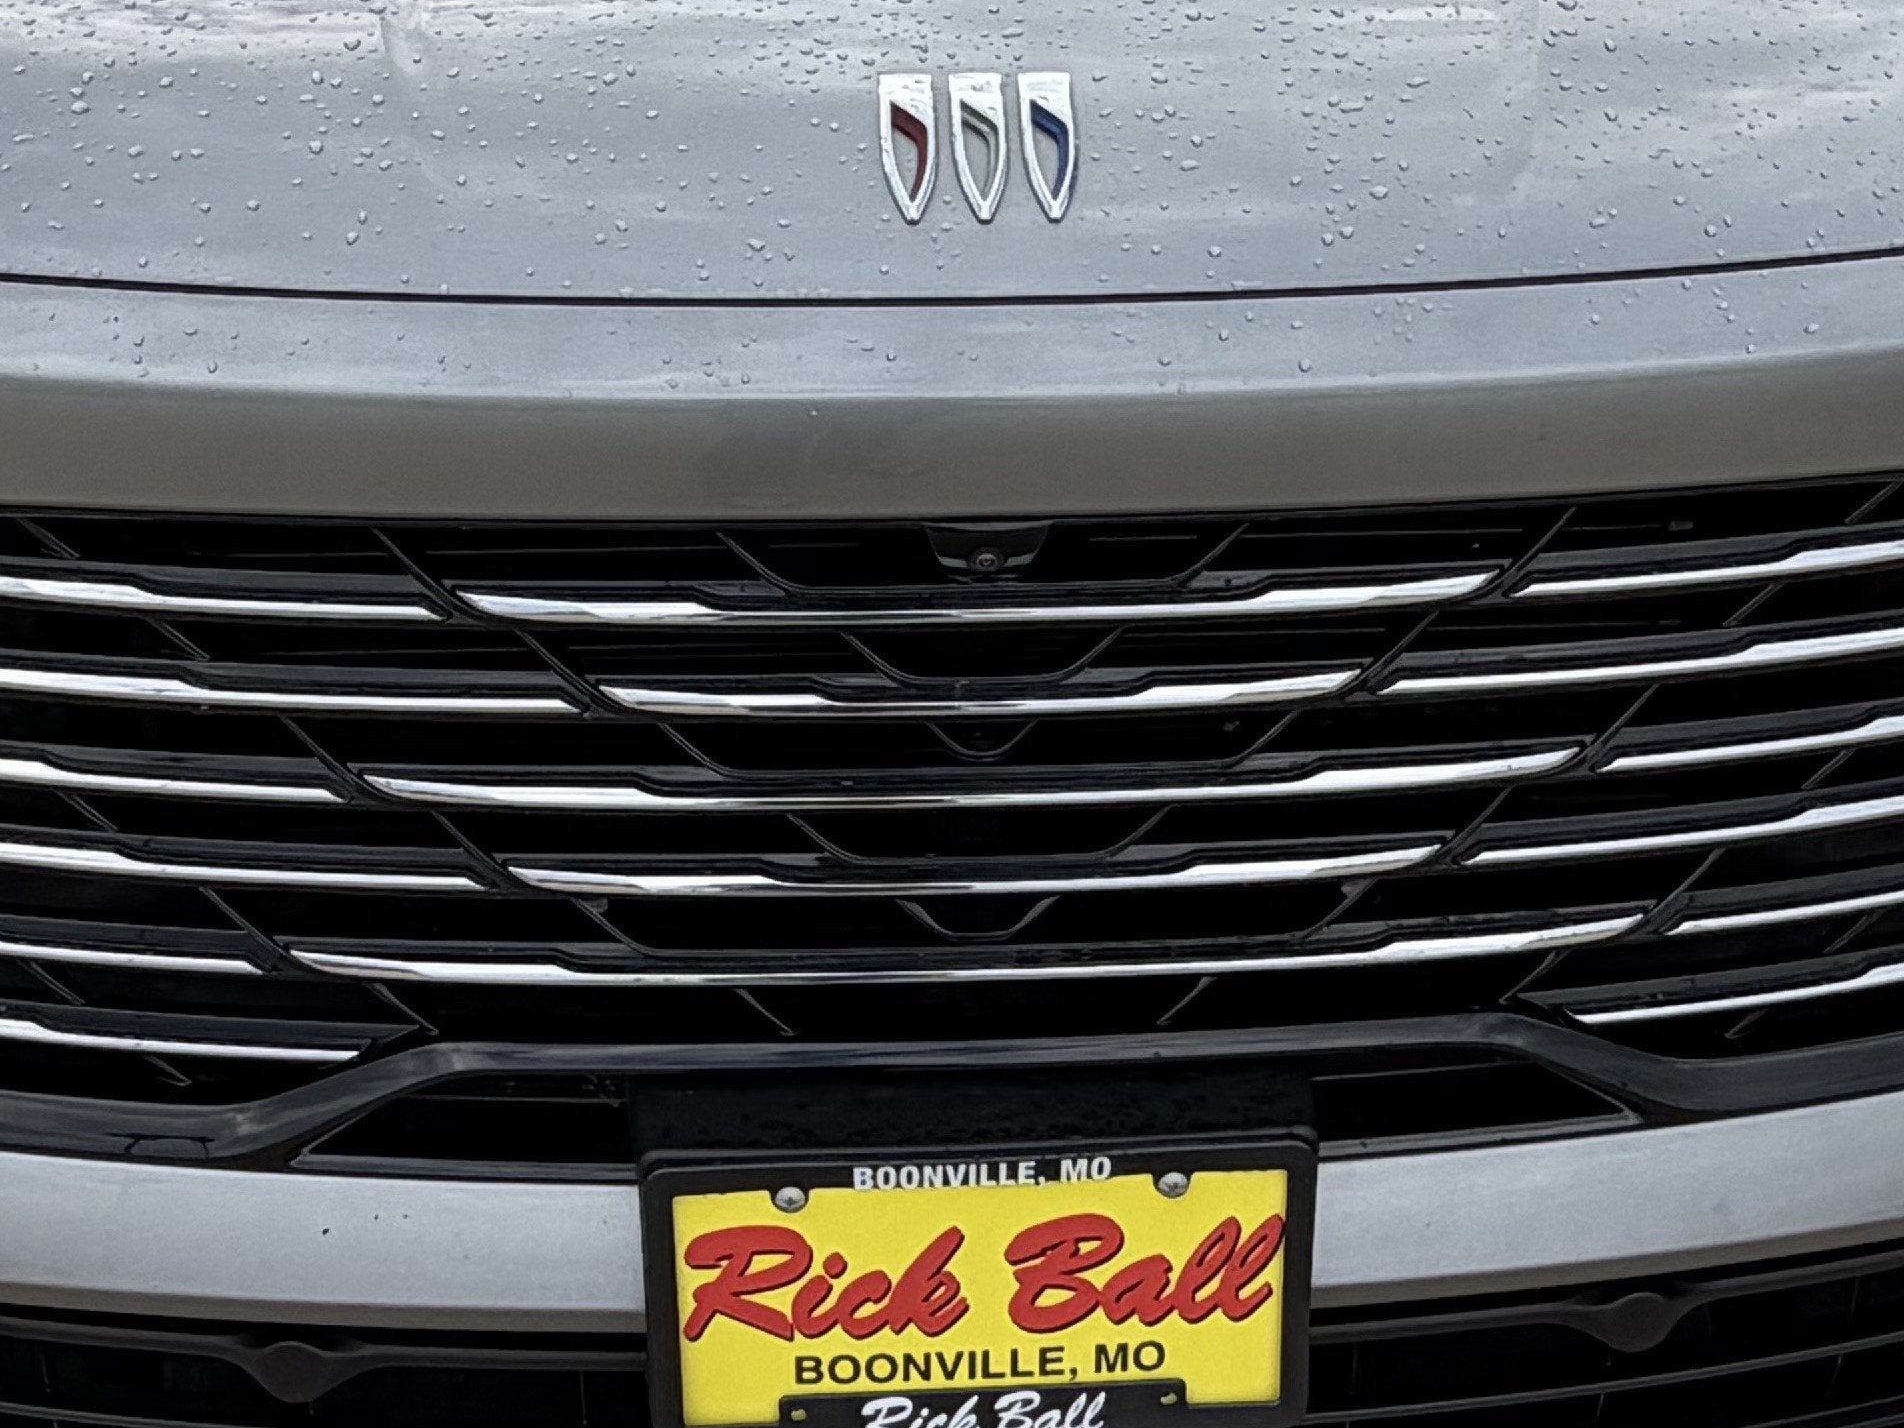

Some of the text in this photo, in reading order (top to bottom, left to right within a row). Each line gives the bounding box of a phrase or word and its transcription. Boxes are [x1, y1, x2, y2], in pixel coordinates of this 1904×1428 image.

[853, 1155, 1112, 1192] BOONVILLE, MO
[682, 1212, 1286, 1342] Rick Ball
[795, 1340, 1165, 1384] BOONVILLE, MO
